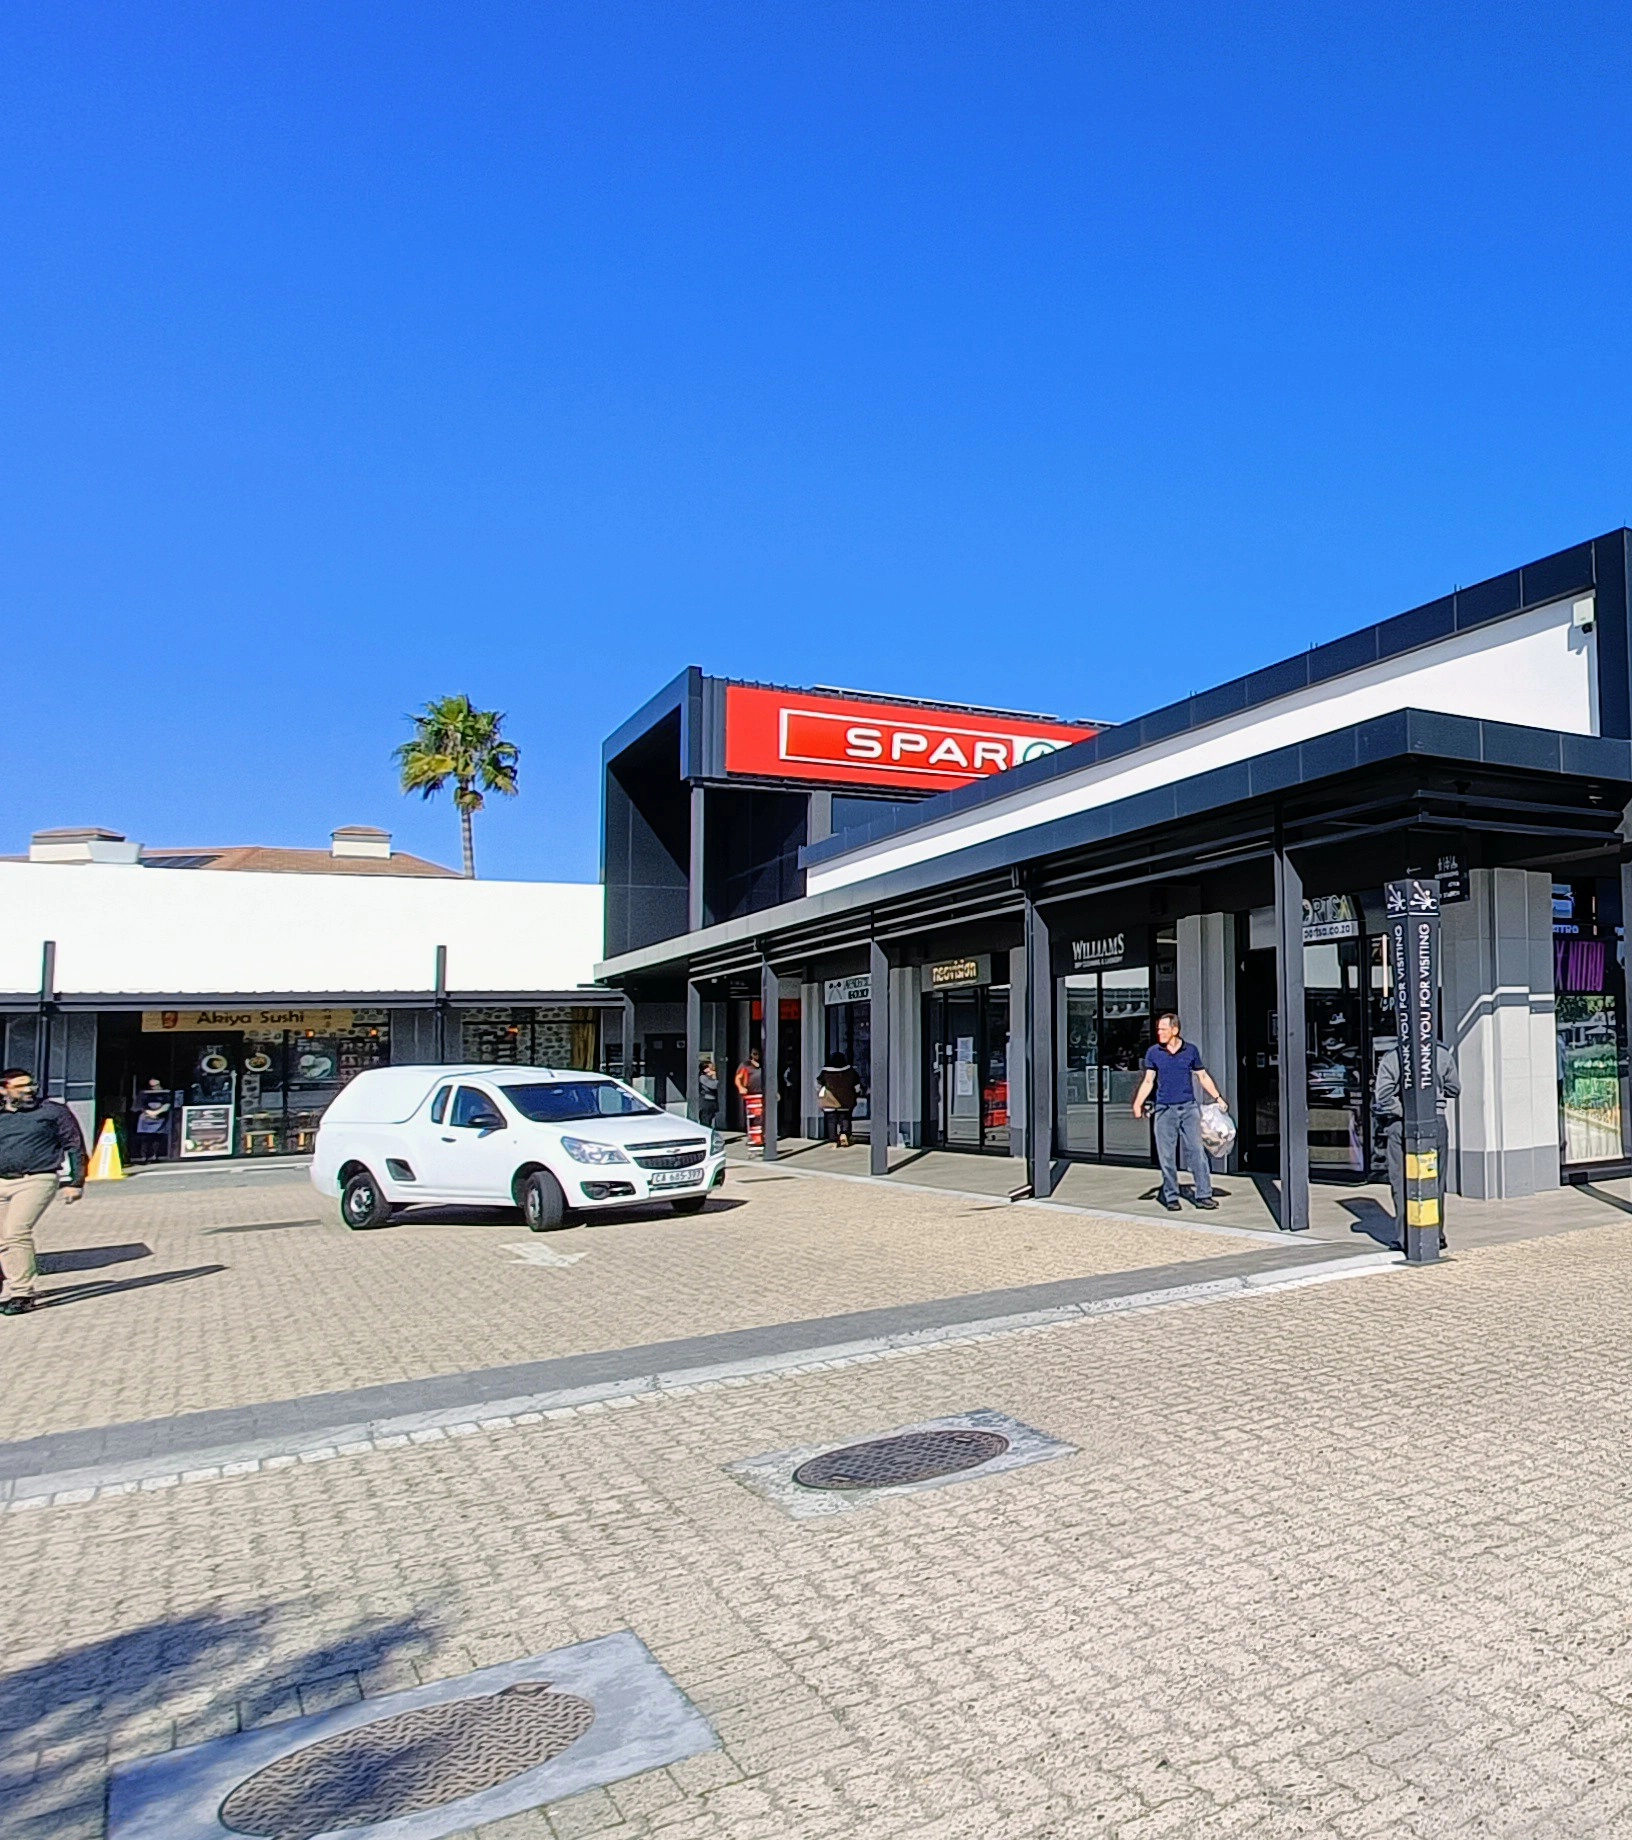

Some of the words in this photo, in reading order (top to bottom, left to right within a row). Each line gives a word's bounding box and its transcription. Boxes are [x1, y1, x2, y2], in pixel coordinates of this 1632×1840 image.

[845, 727, 1008, 771] SPAR
[1302, 895, 1356, 925] ORTSA
[1072, 933, 1124, 960] WILLIAMS
[1394, 924, 1405, 981] VISITING
[1418, 923, 1431, 979] VISITING
[1398, 982, 1408, 1009] FOR
[1419, 980, 1431, 1008] FOR
[197, 1011, 251, 1026] Akiya
[260, 1010, 305, 1024] Sushi
[1400, 1012, 1410, 1041] YOU
[1420, 1011, 1432, 1041] YOU
[1402, 1044, 1412, 1090] THANK
[1421, 1043, 1432, 1090] THANK
